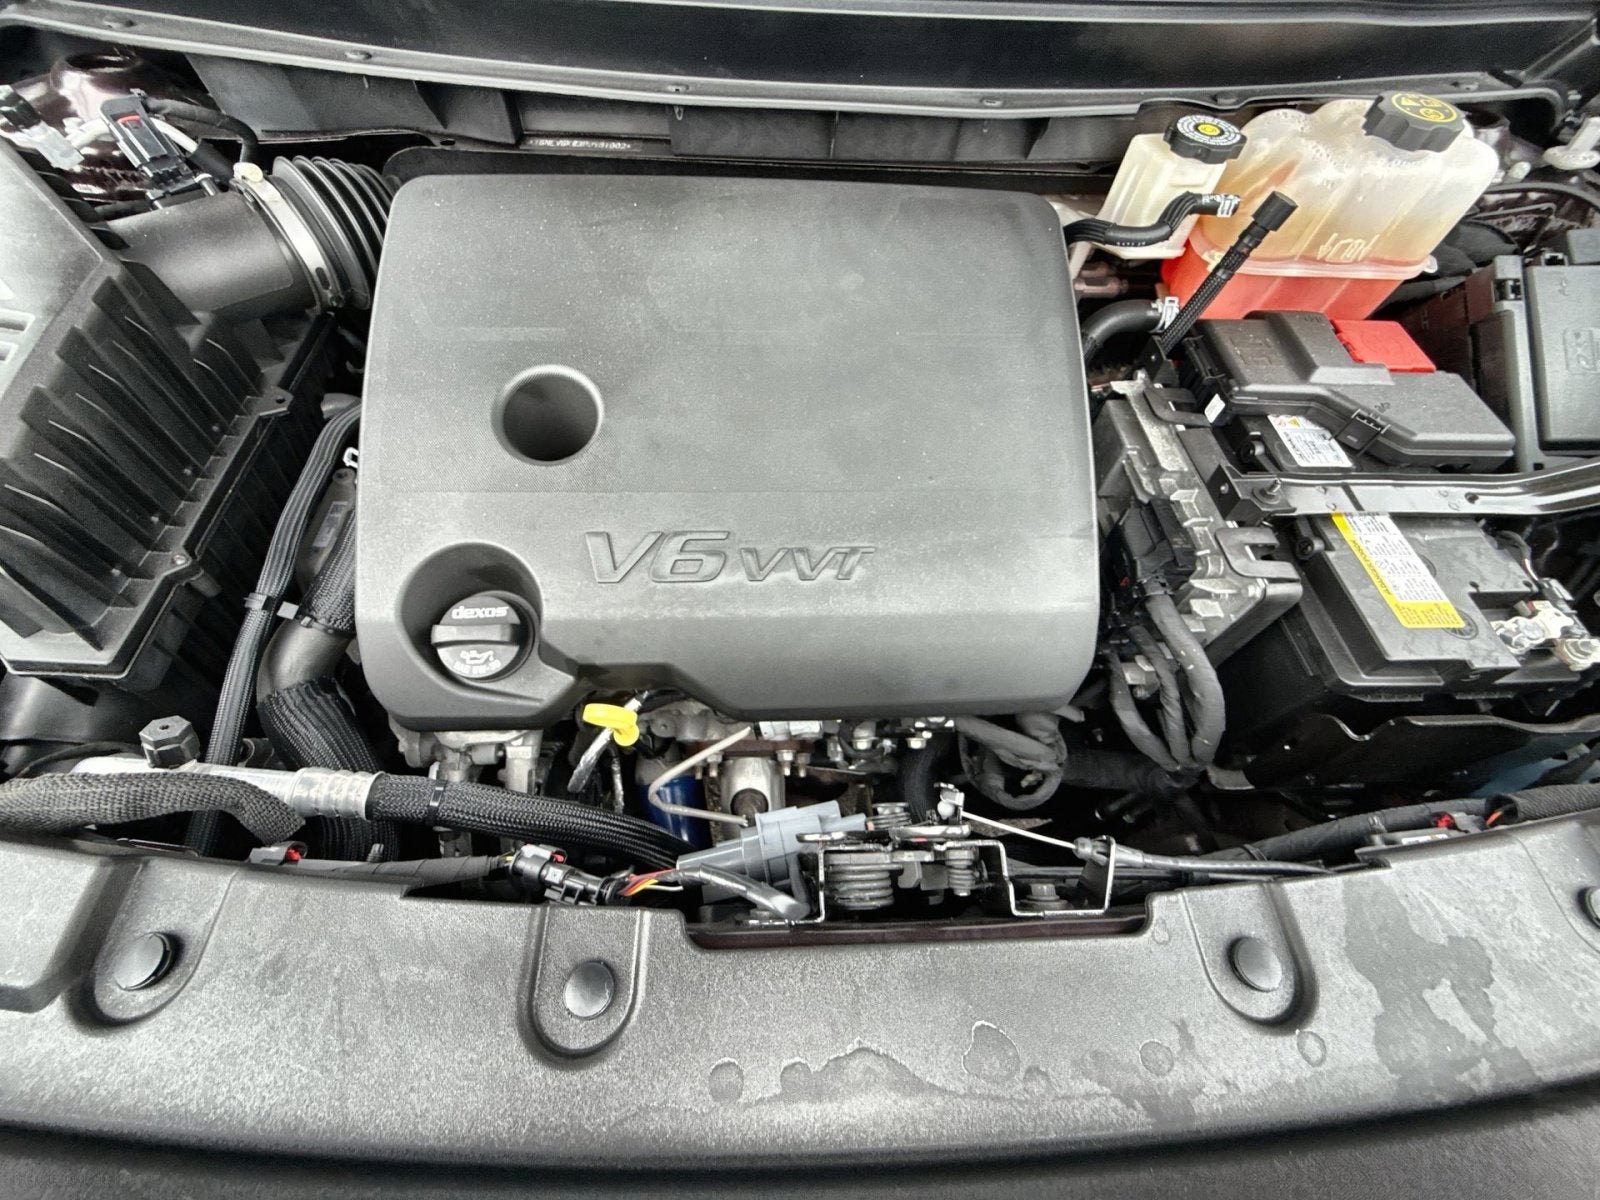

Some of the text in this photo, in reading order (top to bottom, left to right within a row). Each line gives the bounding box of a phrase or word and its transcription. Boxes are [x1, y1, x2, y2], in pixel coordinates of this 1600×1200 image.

[585, 531, 876, 583] V6 VVT
[452, 605, 509, 619] dexos
